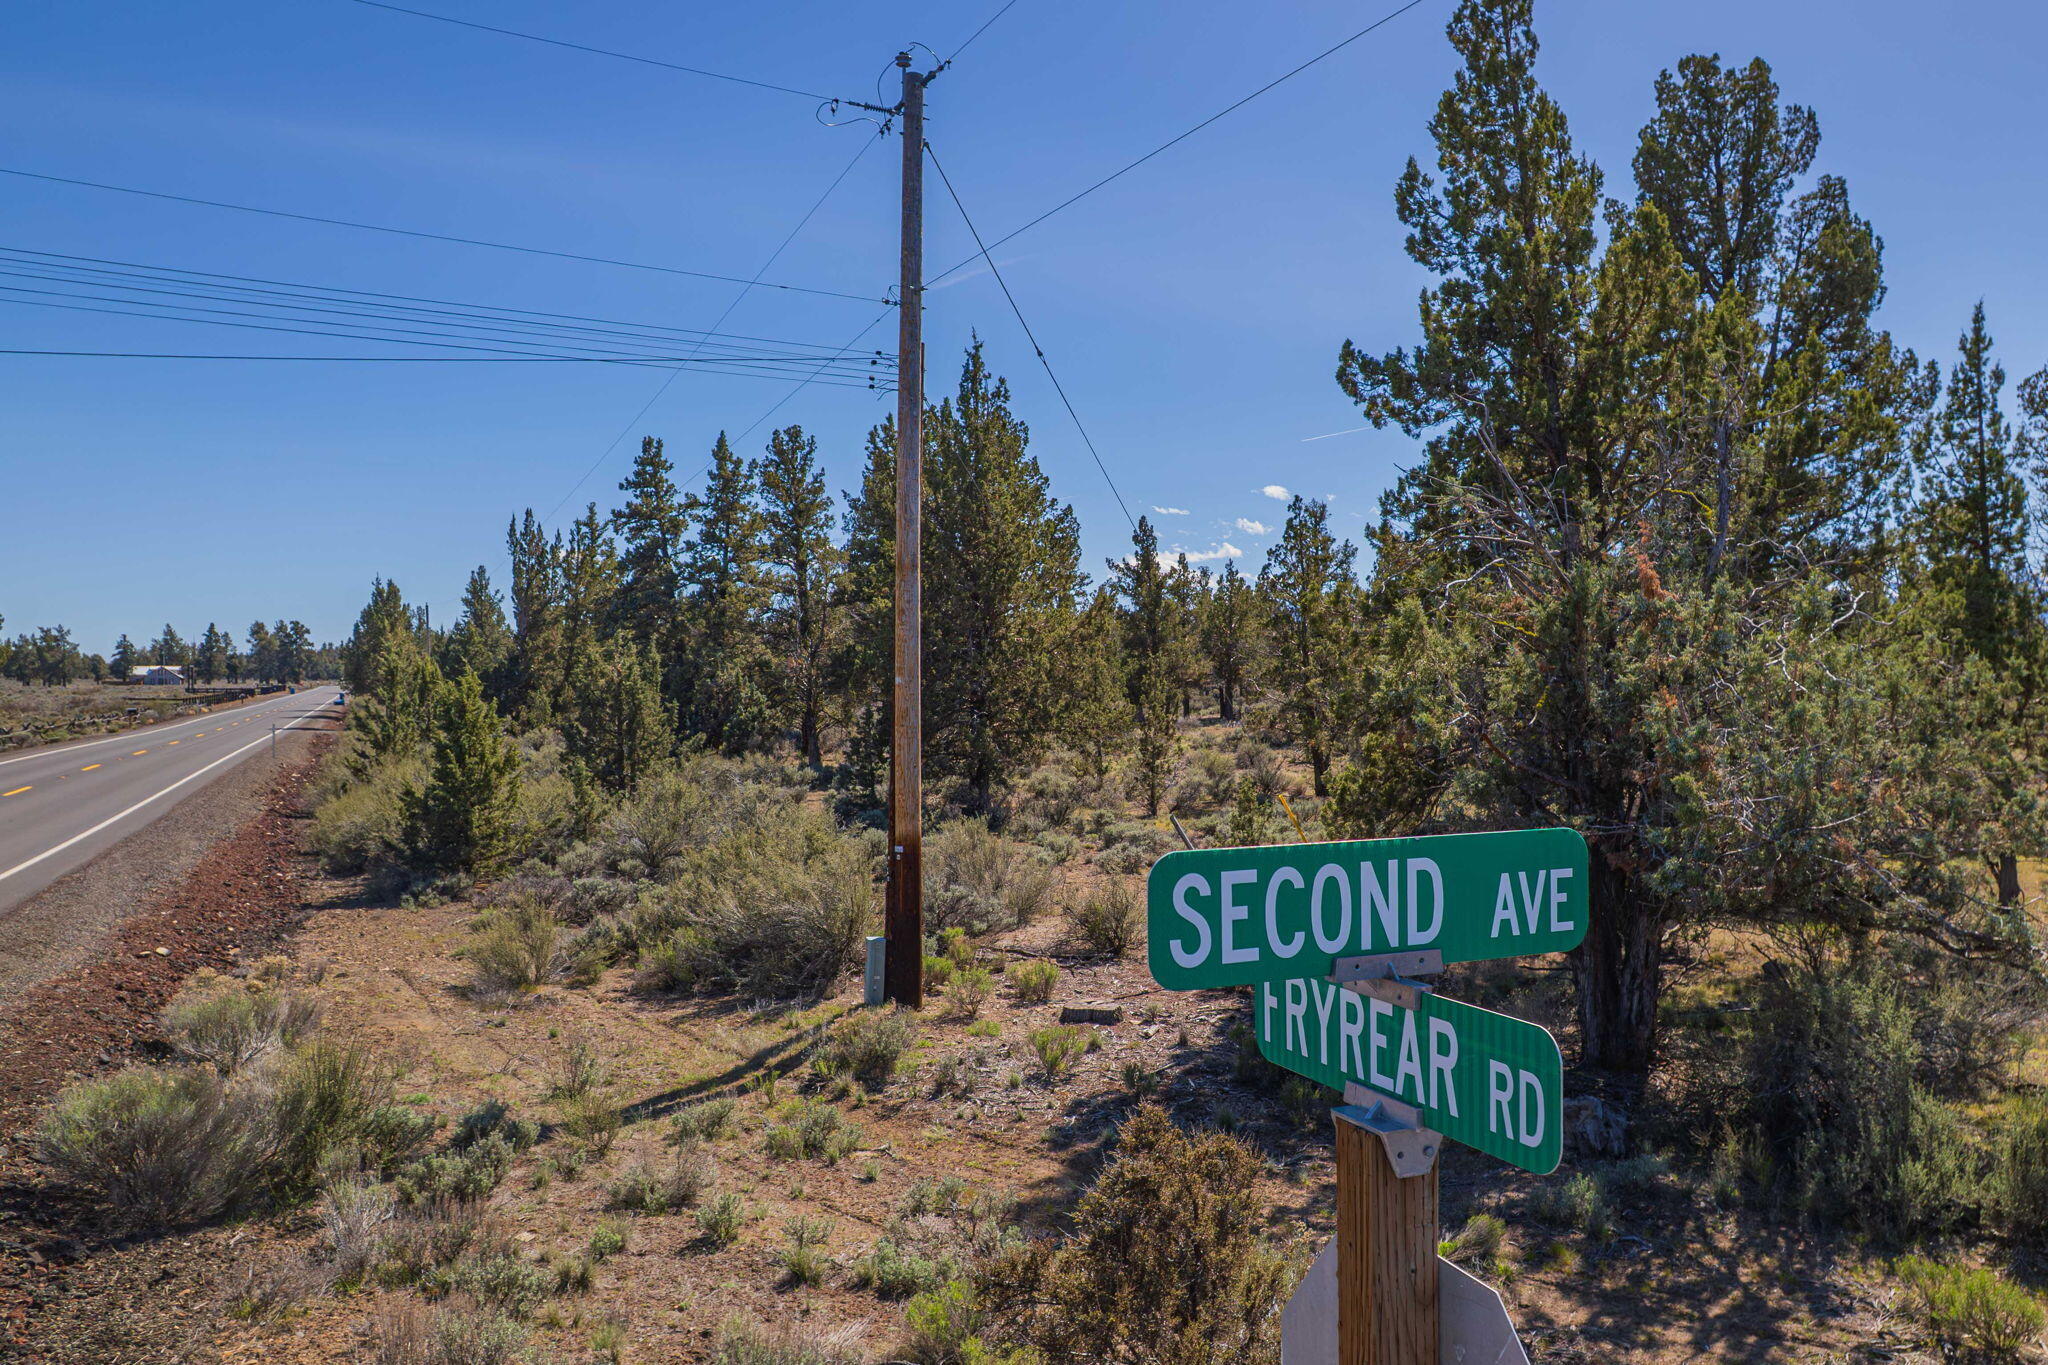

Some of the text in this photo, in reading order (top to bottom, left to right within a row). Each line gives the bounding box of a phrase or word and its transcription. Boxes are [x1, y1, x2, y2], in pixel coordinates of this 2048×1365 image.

[1169, 857, 1575, 968] SECOND AVE
[1264, 978, 1546, 1148] FRYREAR RD
